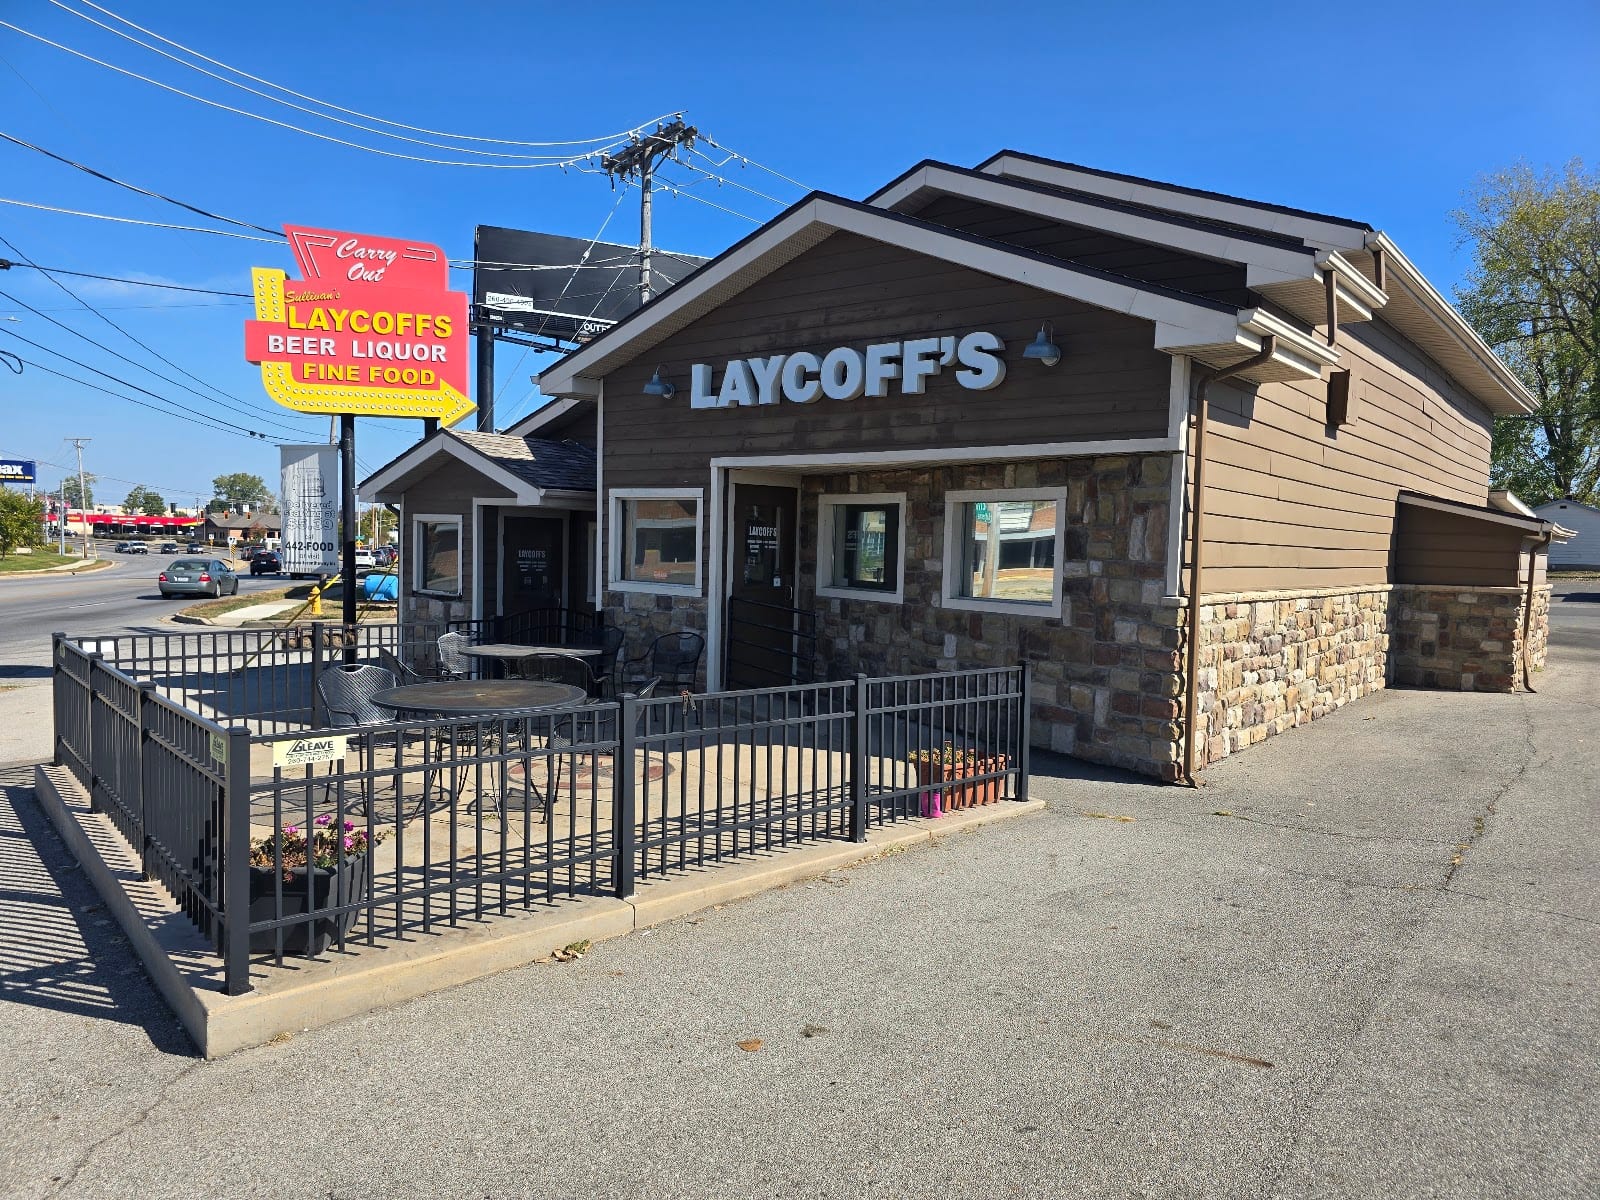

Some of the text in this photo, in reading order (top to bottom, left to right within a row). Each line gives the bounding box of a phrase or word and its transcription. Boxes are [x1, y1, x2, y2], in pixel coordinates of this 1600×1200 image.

[336, 239, 398, 267] Carry
[347, 263, 386, 282] Out
[284, 289, 341, 304] Sullivan's
[288, 305, 453, 338] LAYCOFFS
[268, 335, 448, 362] BEER LIQUOR
[303, 363, 436, 385] FINE FOOD
[691, 331, 1006, 409] LAYCOFF'S
[0, 464, 23, 475] ax
[285, 541, 334, 552] 442-FOOD
[292, 741, 334, 752] GLEAVE
